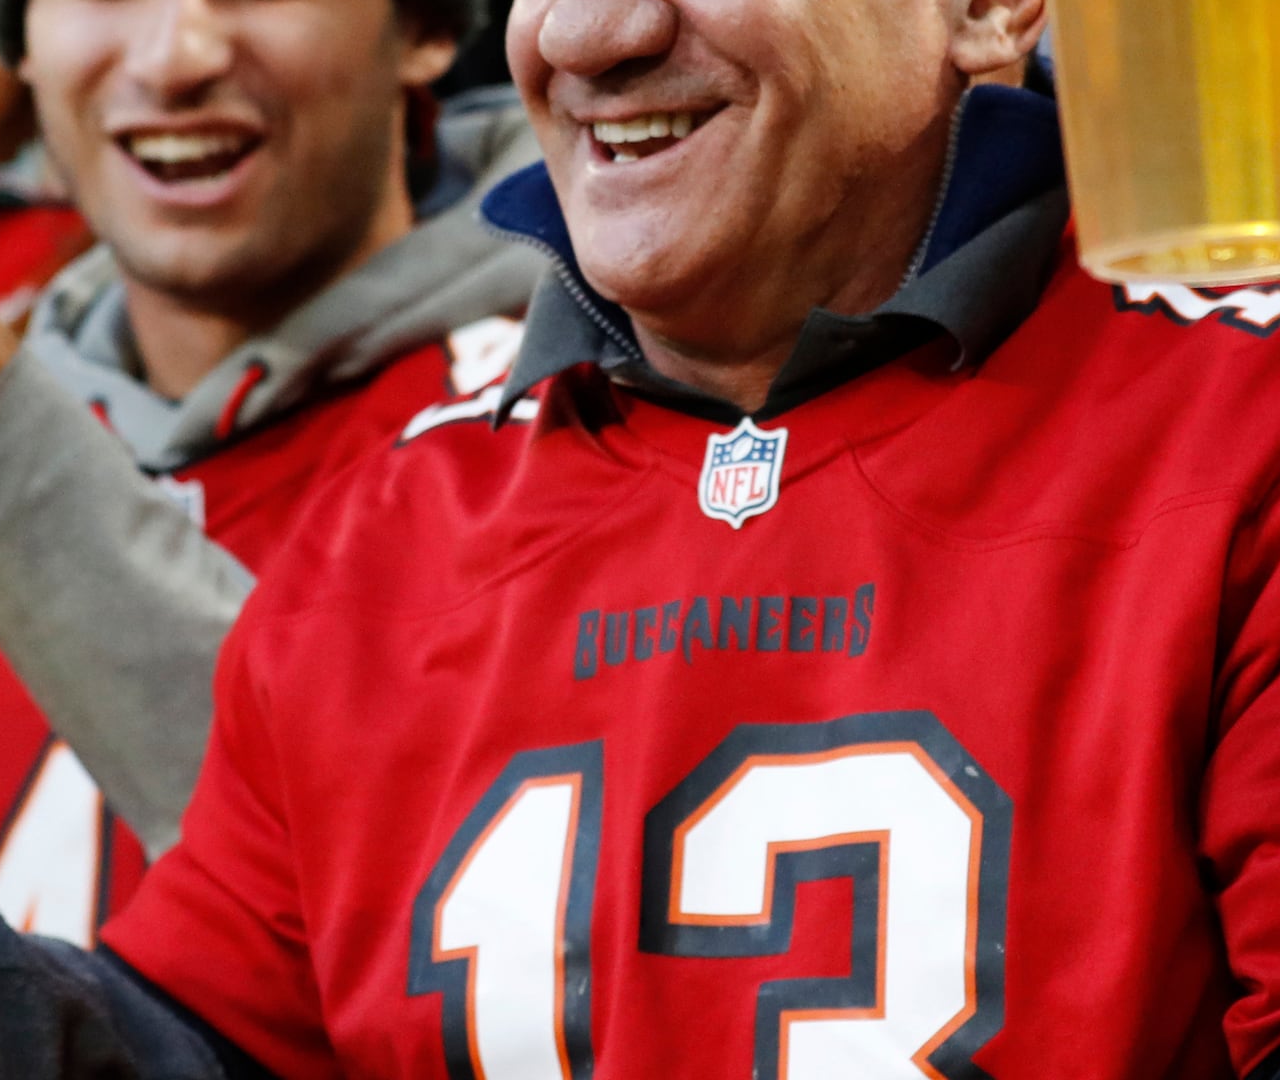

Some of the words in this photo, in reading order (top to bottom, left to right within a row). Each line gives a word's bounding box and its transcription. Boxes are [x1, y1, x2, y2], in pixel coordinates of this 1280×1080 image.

[711, 466, 765, 507] NFL
[573, 582, 876, 681] BUCCANEERS
[406, 709, 1015, 1080] 13
